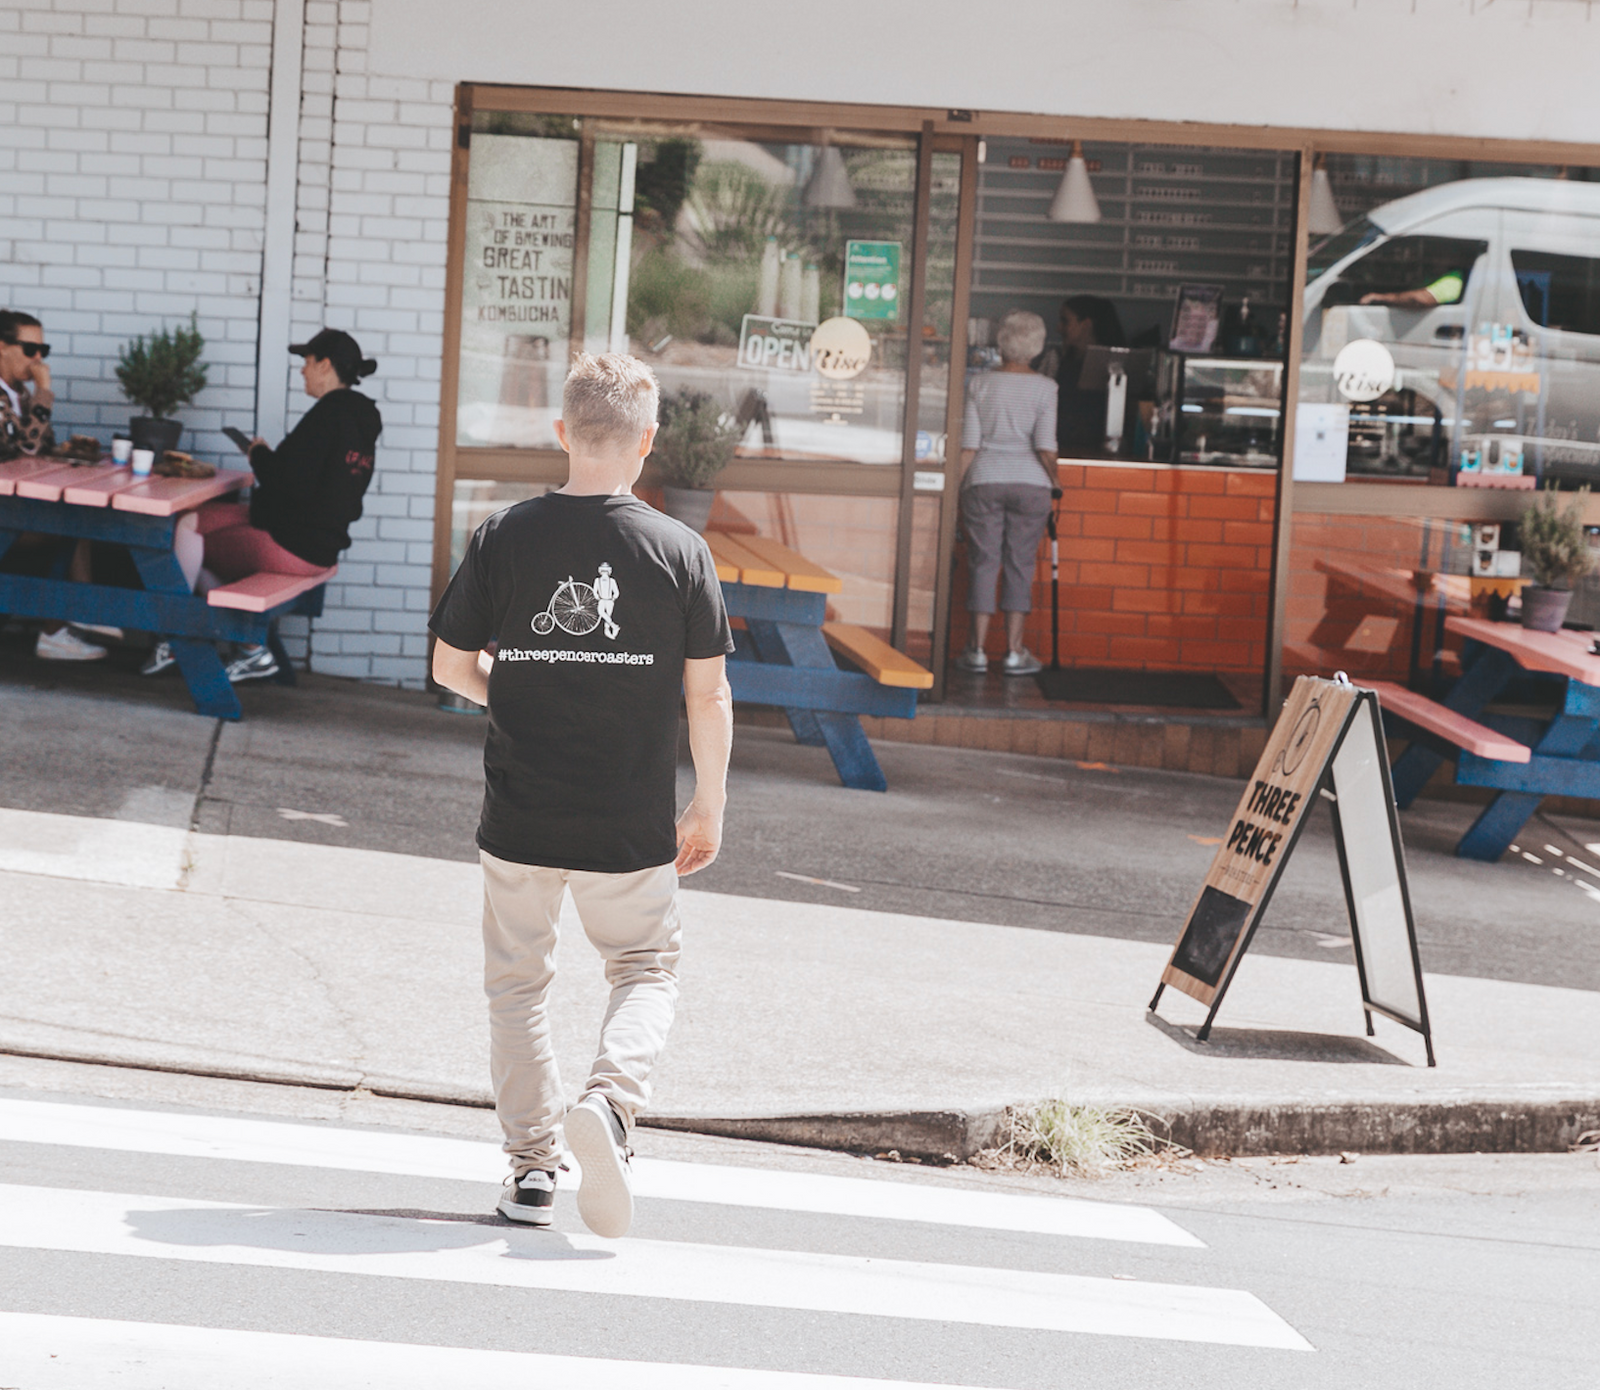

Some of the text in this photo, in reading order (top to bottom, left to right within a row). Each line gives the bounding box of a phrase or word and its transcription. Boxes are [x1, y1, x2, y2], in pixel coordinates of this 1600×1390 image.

[502, 212, 556, 229] THE ART
[494, 229, 574, 249] OF BREWING
[483, 246, 543, 271] GREAT
[497, 275, 570, 300] TASTIN
[478, 305, 560, 322] KOMBUCHA
[746, 334, 810, 371] OPEN
[498, 648, 654, 666] #threepenceroasters
[1247, 780, 1302, 826] THREE
[1227, 819, 1283, 867] PENCE
